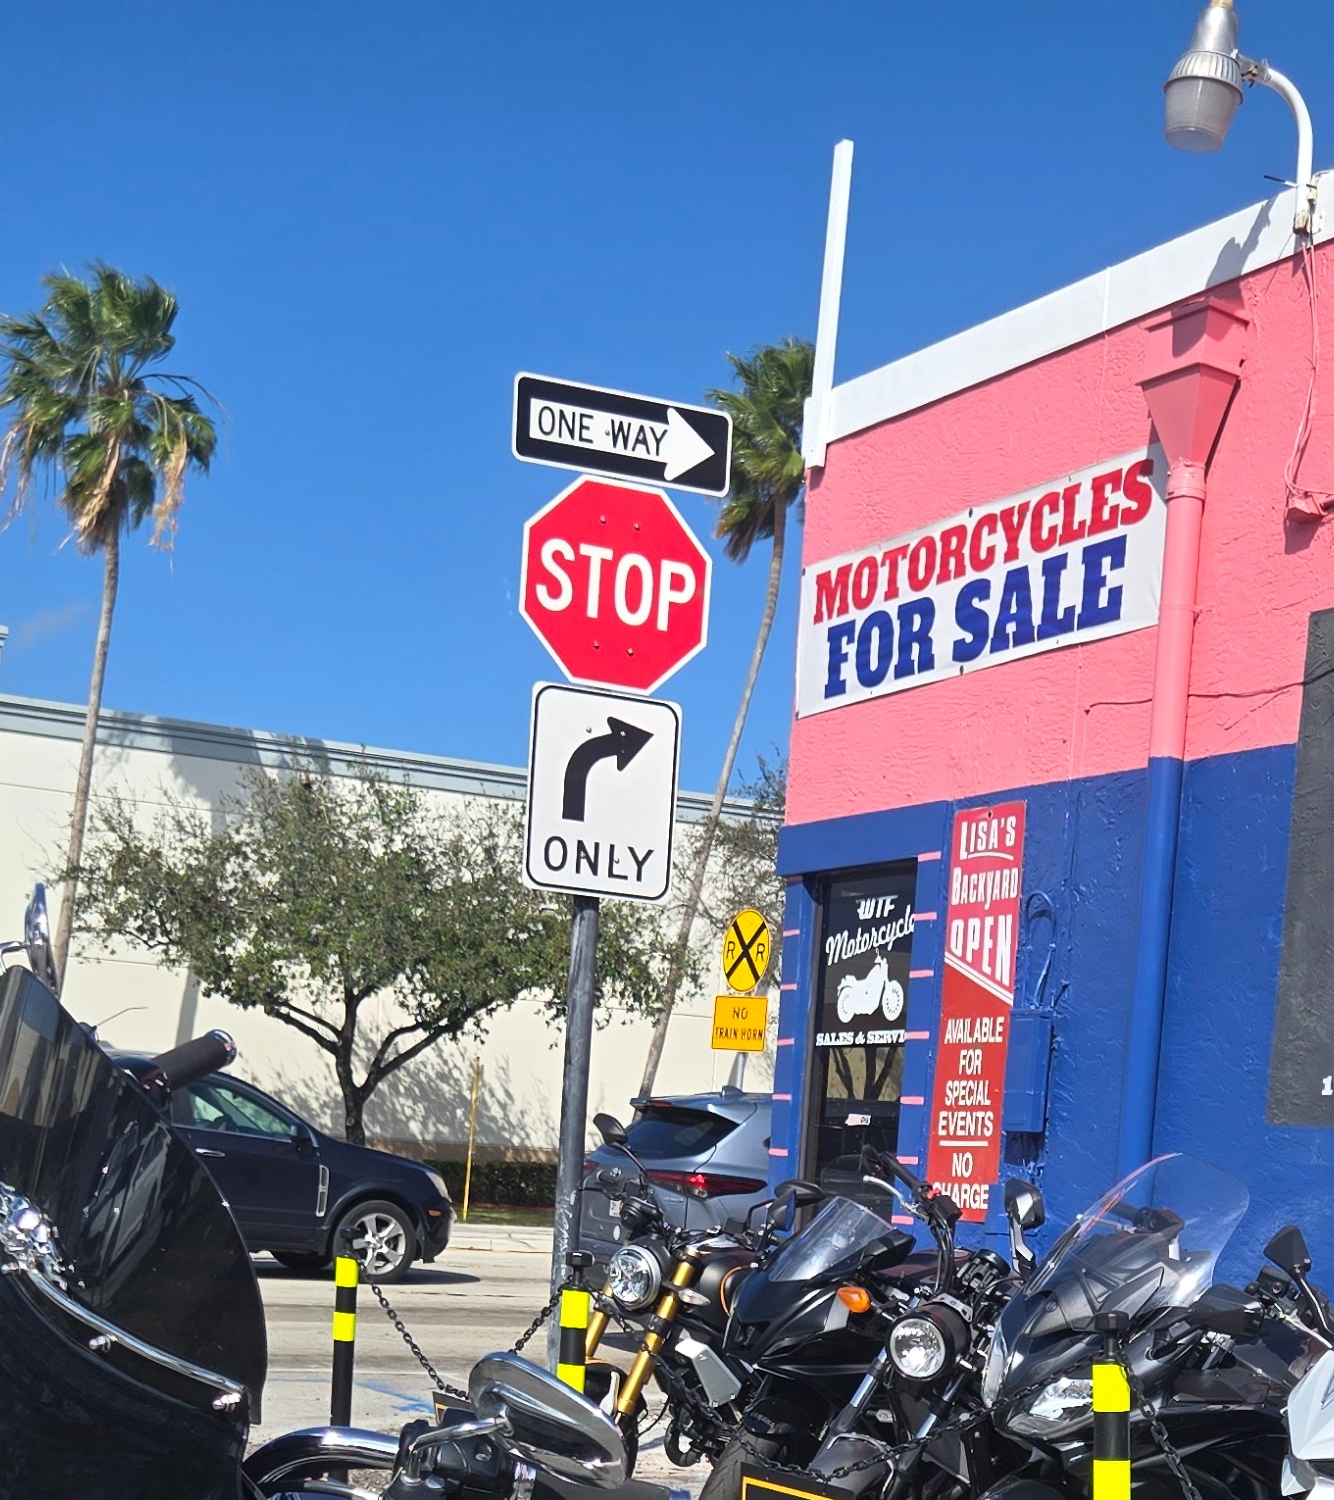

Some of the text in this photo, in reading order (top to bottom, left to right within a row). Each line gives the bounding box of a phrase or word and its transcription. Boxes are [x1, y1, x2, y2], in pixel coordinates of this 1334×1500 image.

[538, 405, 667, 457] ONE WAY
[812, 459, 1154, 624] MOTORCYCLES
[535, 537, 696, 632] STOP
[824, 535, 1127, 699] FOR SALE
[960, 815, 1017, 860] LISA'S
[543, 835, 654, 883] ONLY
[951, 867, 1018, 910] BACKYARD
[856, 895, 899, 920] WTF
[726, 941, 765, 962] R R
[950, 914, 1013, 987] OPEN
[733, 1006, 748, 1020] NO
[715, 1027, 763, 1041] TRAIN HORN
[815, 1031, 854, 1046] SALES
[855, 1031, 865, 1045] &
[944, 1016, 1005, 1044] AVAILABLE
[959, 1049, 982, 1075] FOR
[944, 1080, 991, 1106] SPECIAL
[1321, 1075, 1334, 1096] 1
[938, 1111, 994, 1137] EVENTS
[951, 1152, 973, 1177] NO
